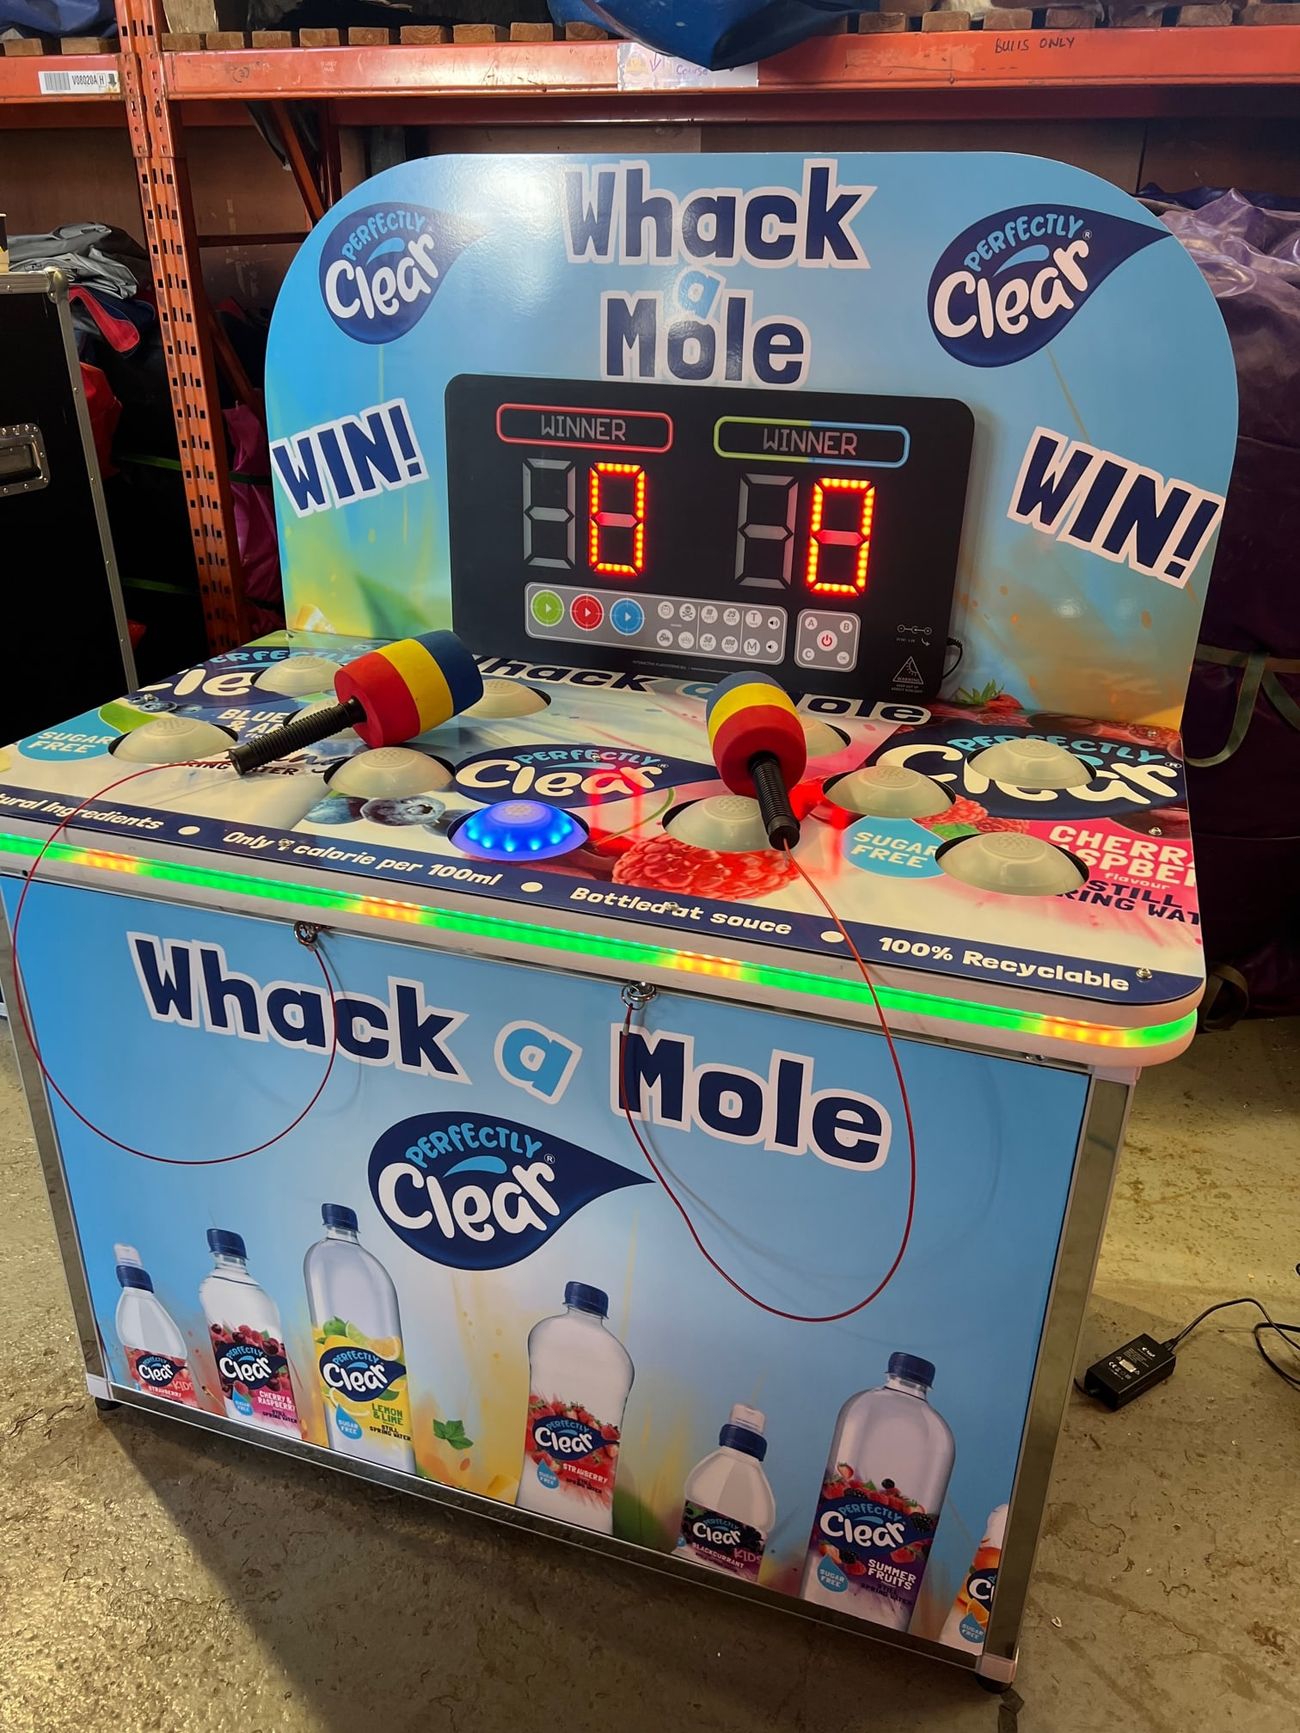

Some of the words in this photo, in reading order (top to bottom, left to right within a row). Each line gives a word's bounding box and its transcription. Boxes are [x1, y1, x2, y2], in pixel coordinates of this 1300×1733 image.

[1039, 37, 1075, 49] ONLY
[563, 165, 864, 262] Whack
[341, 210, 426, 262] PERFECTLY
[963, 213, 1084, 272] PERFECTLY
[325, 233, 439, 319] Clear
[933, 239, 1089, 339] Clear
[676, 269, 722, 320] a
[604, 295, 806, 385] Mole
[540, 413, 627, 442] WINNER
[762, 427, 858, 457] WINNER
[270, 402, 425, 514] WIN!
[1013, 432, 1222, 582] WIN!
[475, 655, 652, 693] hack
[800, 694, 926, 725] ole
[27, 739, 97, 754] FREE
[37, 730, 117, 746] SUGAR
[512, 748, 663, 766] PERFECTLY
[454, 758, 663, 797] Clear
[0, 792, 44, 810] tural
[41, 800, 165, 831] Ingredients
[850, 844, 929, 869] FREE
[853, 831, 938, 857] SUGAR
[222, 830, 275, 850] Only
[293, 843, 376, 866] calorie
[375, 857, 424, 875] per
[427, 863, 504, 887] 100ml
[1086, 879, 1183, 909] STILL
[1103, 872, 1172, 890] flavour
[569, 886, 668, 915] Bottled
[672, 905, 705, 921] at
[709, 912, 793, 936] souce
[1147, 903, 1200, 926] WAT
[878, 936, 954, 962] 100%
[962, 949, 1131, 993] Recyclable
[136, 938, 456, 1077] Whack
[501, 1031, 575, 1098] a
[618, 1031, 886, 1164] Mole
[405, 1122, 543, 1168] PERFECTLY
[378, 1161, 561, 1241] Clear
[226, 1346, 264, 1360] PERFECTLY
[332, 1350, 380, 1365] PERFECTLY
[138, 1363, 174, 1381] Clear
[219, 1356, 272, 1382] Clear
[323, 1362, 388, 1392] Clear
[259, 1390, 286, 1403] CHERRY
[371, 1402, 404, 1418] LEMON
[369, 1425, 393, 1437] SPRING
[373, 1411, 381, 1420] &
[381, 1412, 404, 1426] LIME
[545, 1419, 590, 1433] PERFECTLY
[534, 1426, 593, 1453] Clear
[562, 1463, 609, 1484] STRAWBERRY
[838, 1503, 902, 1522] PERFECTLY
[692, 1521, 741, 1545] Clear
[820, 1510, 905, 1548] Clear
[691, 1542, 745, 1569] BLACKCURRANT
[819, 1568, 845, 1583] SUGAR
[820, 1576, 842, 1588] FREE
[867, 1558, 917, 1584] SUMMER
[867, 1567, 912, 1591] FRUITS
